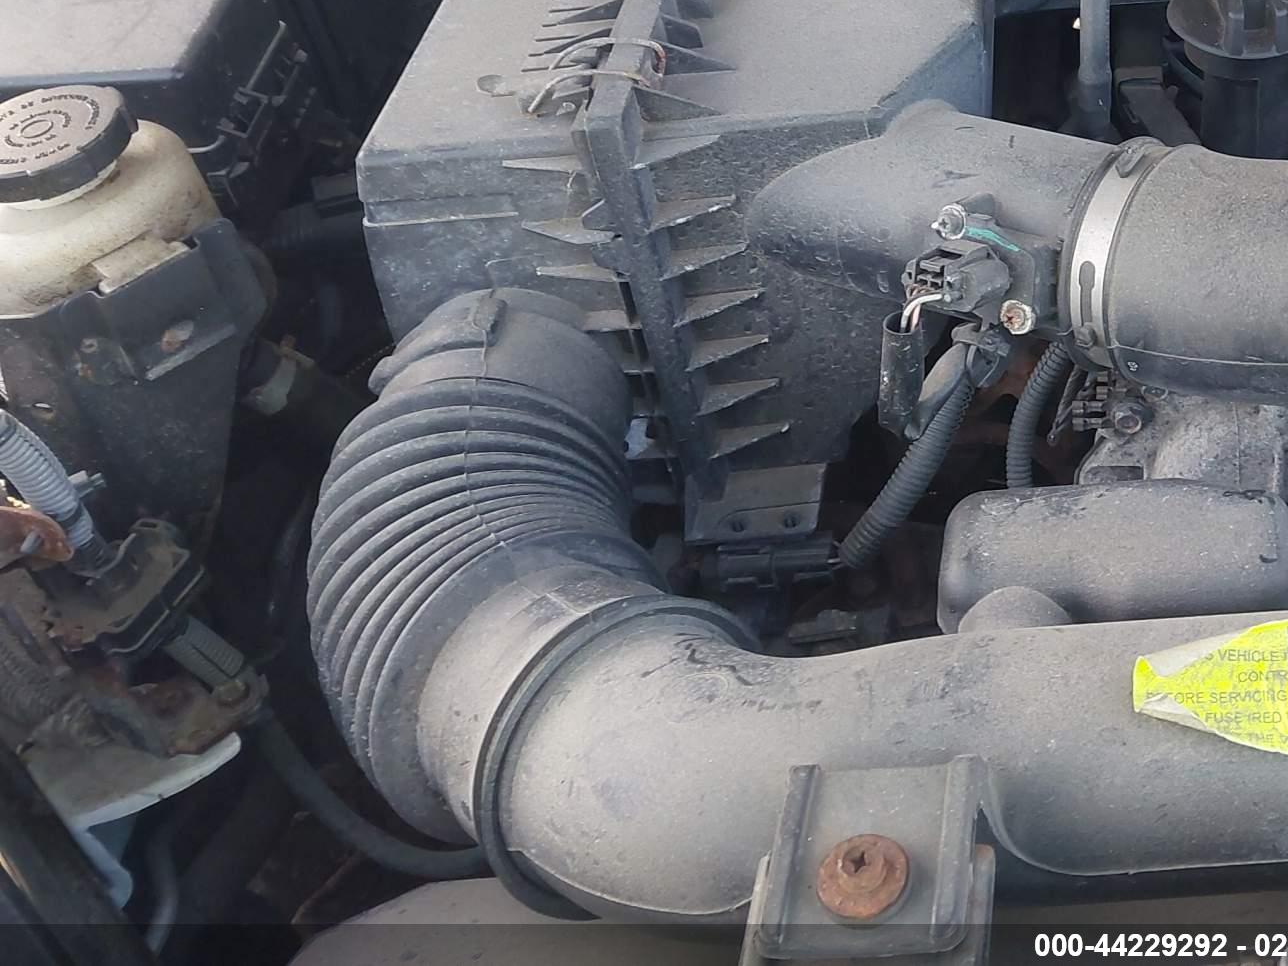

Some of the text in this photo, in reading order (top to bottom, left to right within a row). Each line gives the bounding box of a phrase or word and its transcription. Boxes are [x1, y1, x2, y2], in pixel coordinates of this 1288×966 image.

[1216, 649, 1278, 663] VEHICLE
[1208, 688, 1288, 704] SERVICING
[1204, 711, 1245, 725] FUSE
[1247, 711, 1283, 725] (RED
[1248, 733, 1274, 747] THE
